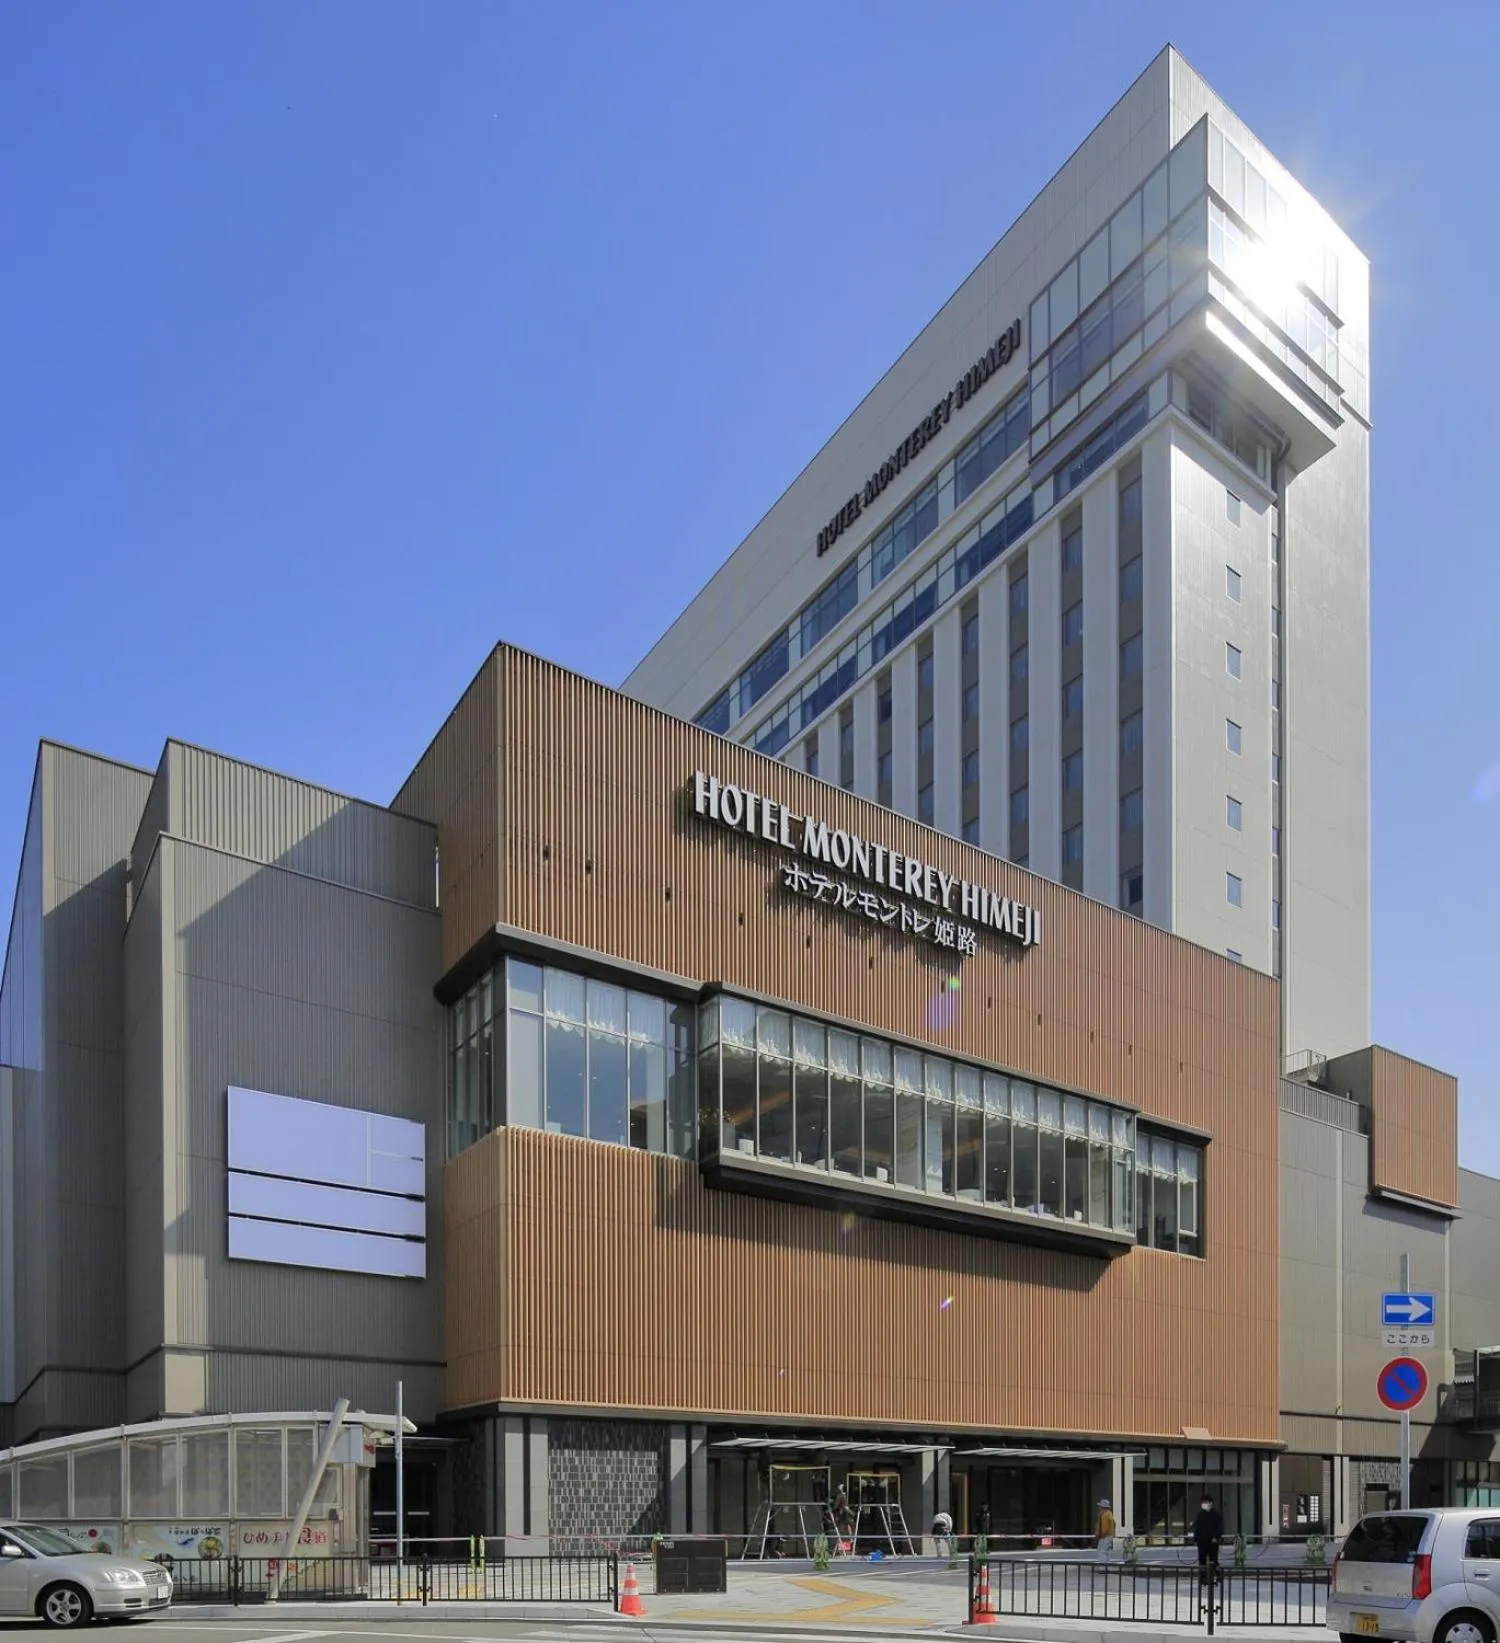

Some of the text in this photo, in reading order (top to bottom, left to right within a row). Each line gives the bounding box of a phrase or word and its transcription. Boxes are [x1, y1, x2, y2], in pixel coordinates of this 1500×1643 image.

[817, 317, 1021, 557] HOTEL MONTEREY HIMEJI
[695, 770, 1040, 946] HOTEL MONTEREY HIMEJI
[784, 862, 978, 956] ホテルモントレ姫路
[1386, 1334, 1430, 1345] ここから
